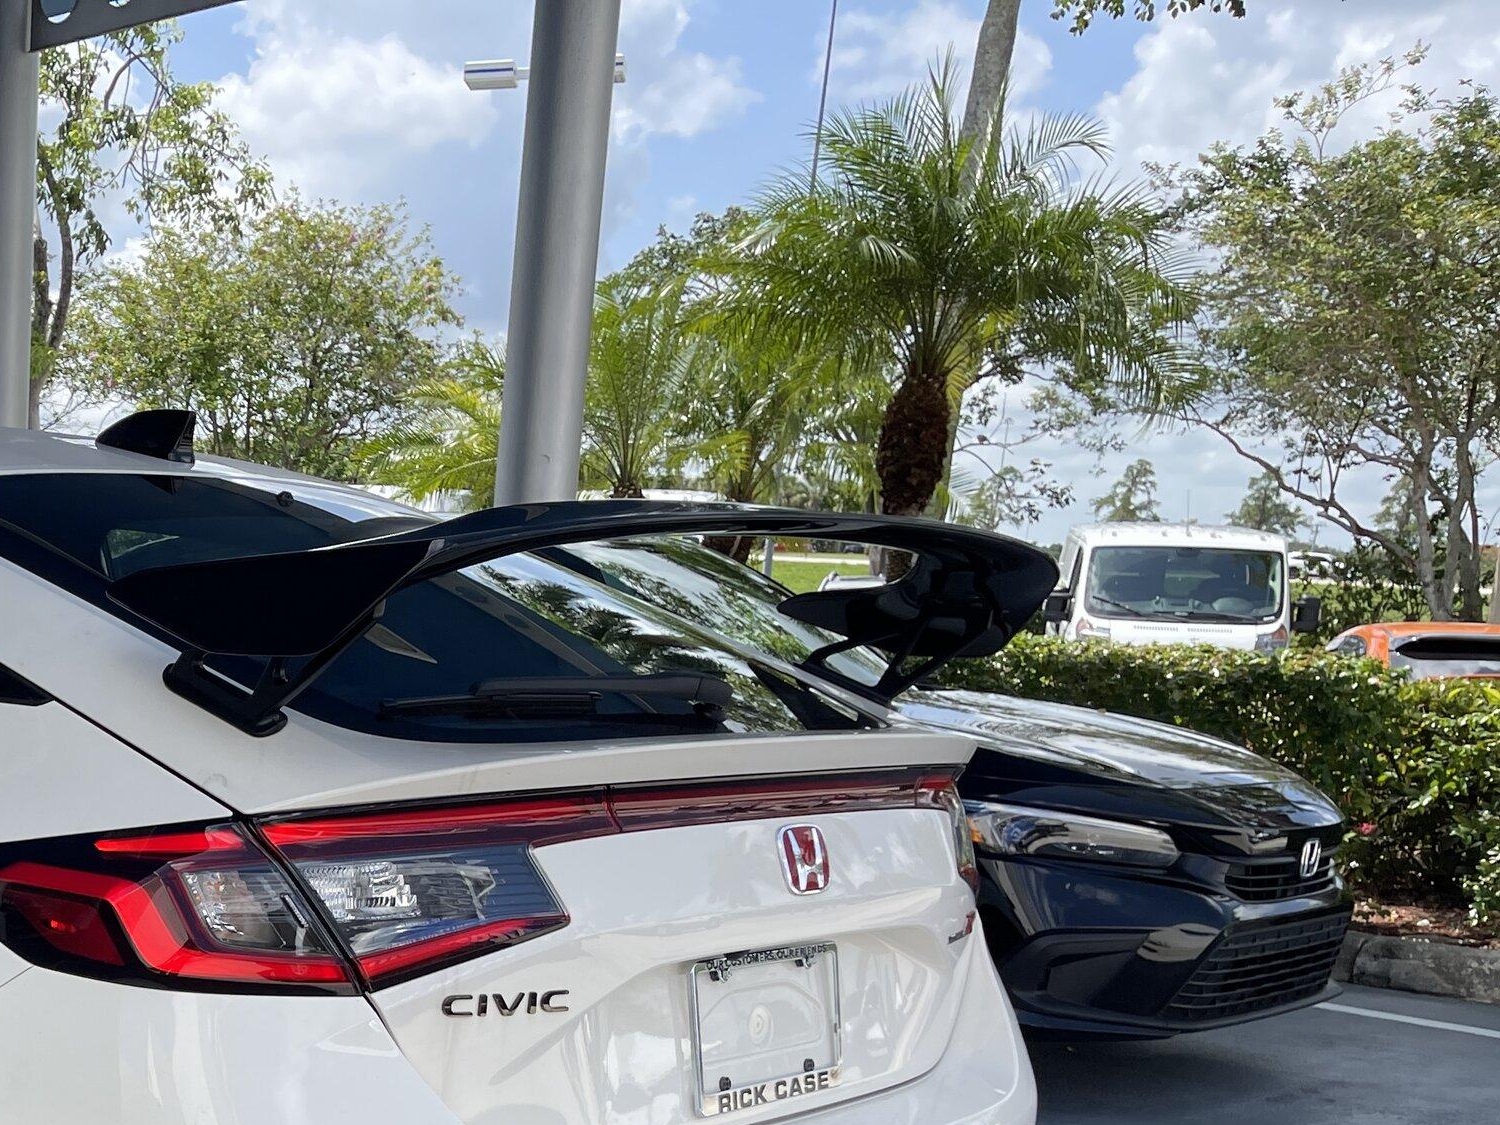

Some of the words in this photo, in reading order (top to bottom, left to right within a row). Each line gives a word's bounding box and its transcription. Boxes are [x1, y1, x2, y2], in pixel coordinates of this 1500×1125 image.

[795, 944, 827, 957] FRIENDS
[442, 989, 570, 1017] CIVIC
[718, 1084, 768, 1113] RICK
[775, 1070, 829, 1100] CASE
